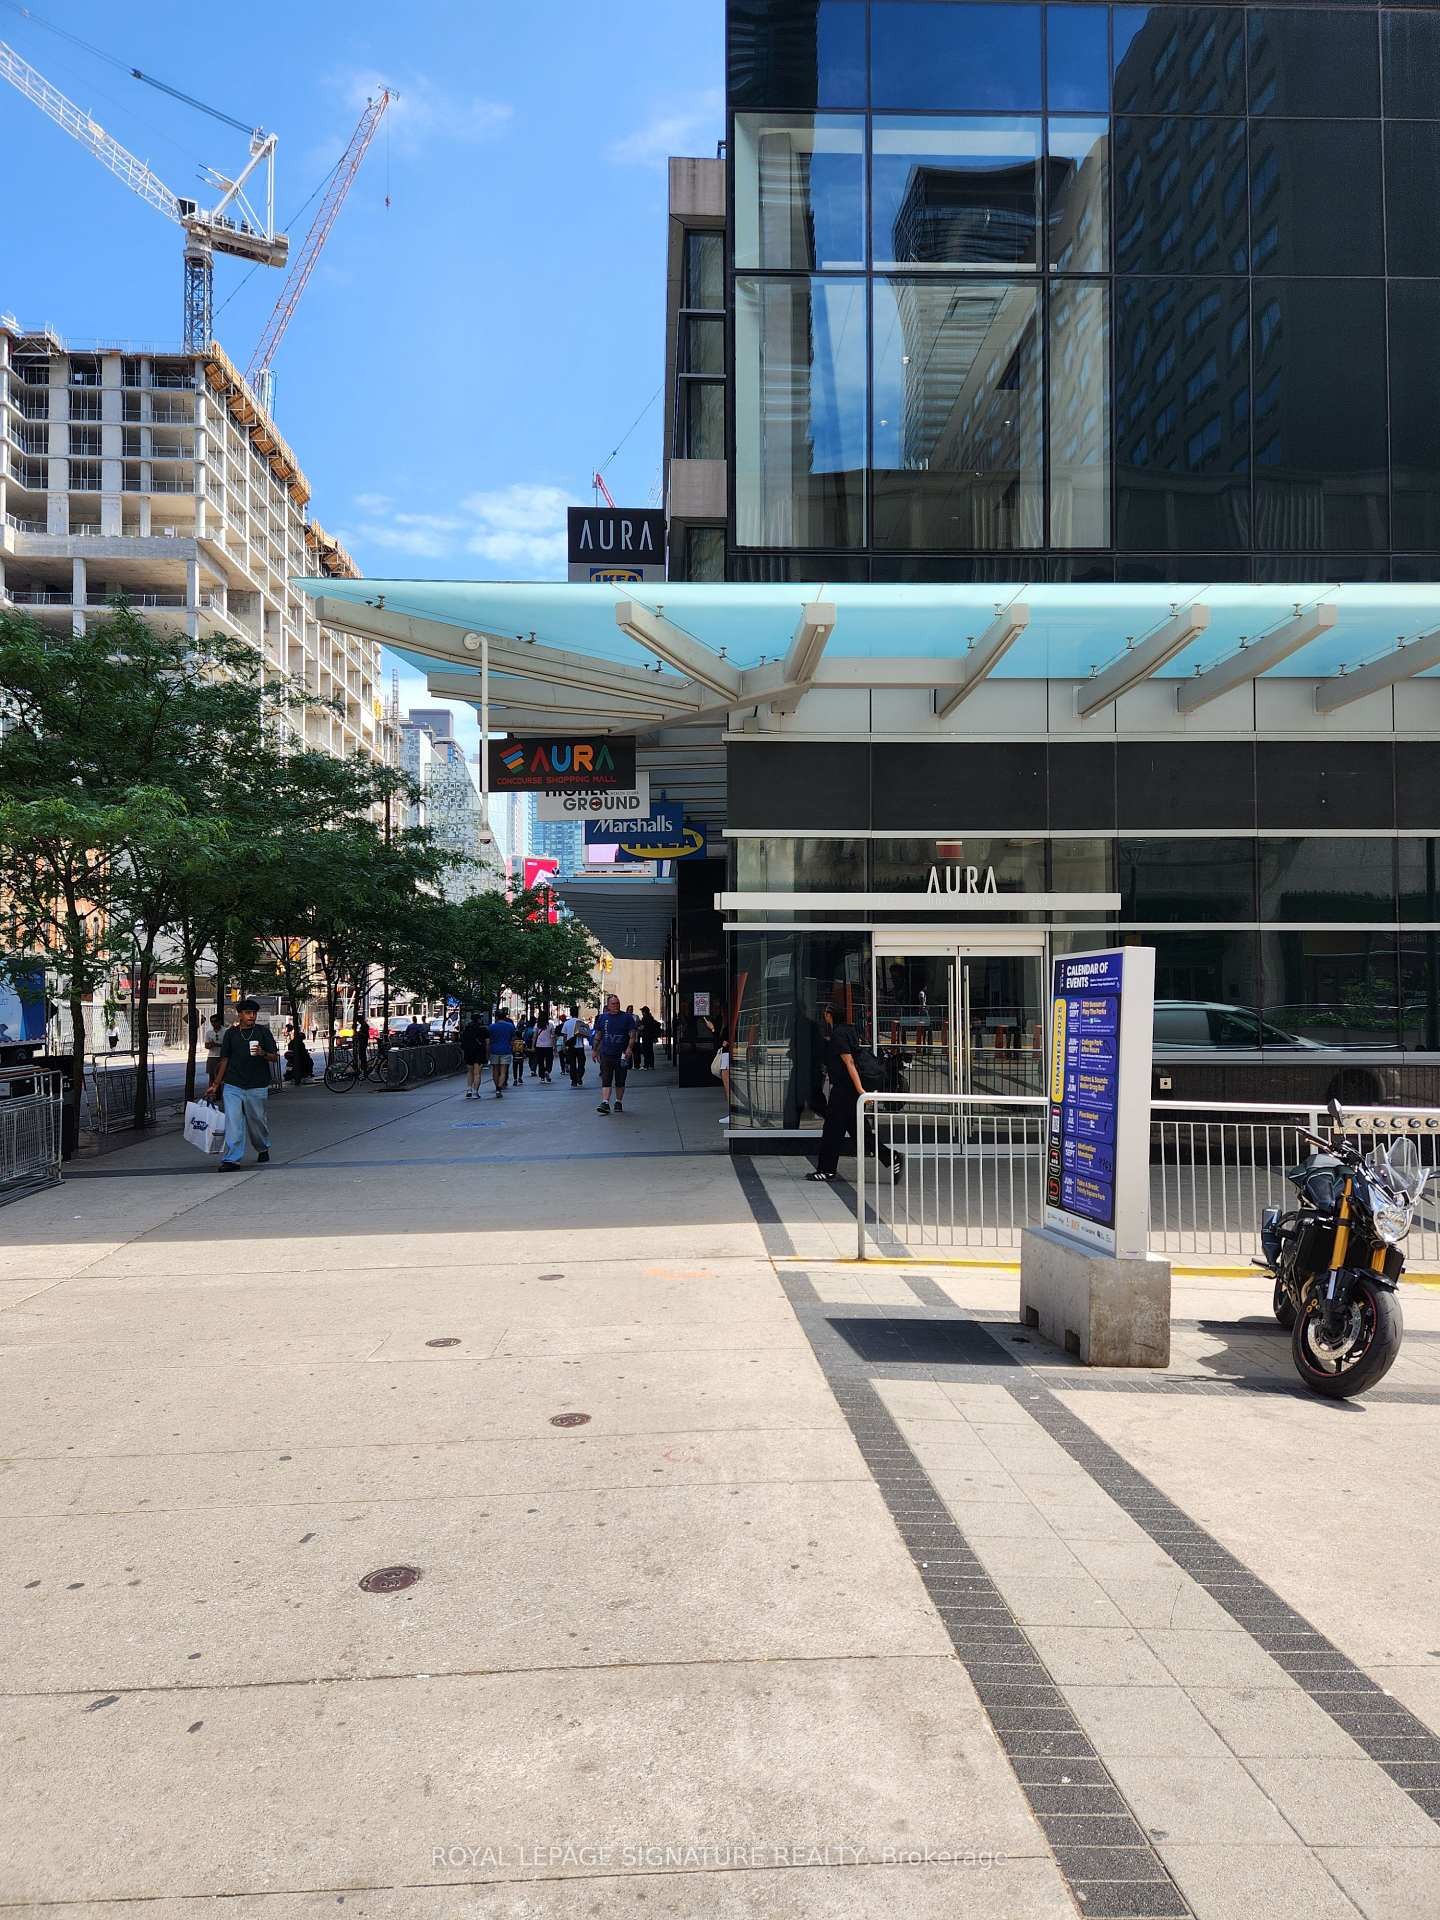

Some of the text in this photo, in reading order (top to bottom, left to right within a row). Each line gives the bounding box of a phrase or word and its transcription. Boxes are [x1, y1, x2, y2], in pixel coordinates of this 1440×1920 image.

[580, 520, 653, 551] AURA
[530, 744, 615, 772] AURA
[496, 775, 616, 785] CONCOURSE SHOPPING MALL
[562, 796, 640, 811] GROUND
[593, 815, 672, 833] Marshalls
[927, 866, 998, 894] AURA
[1066, 963, 1098, 976] CALENDAR
[1100, 962, 1108, 974] OF
[1066, 976, 1089, 988] EVENTS
